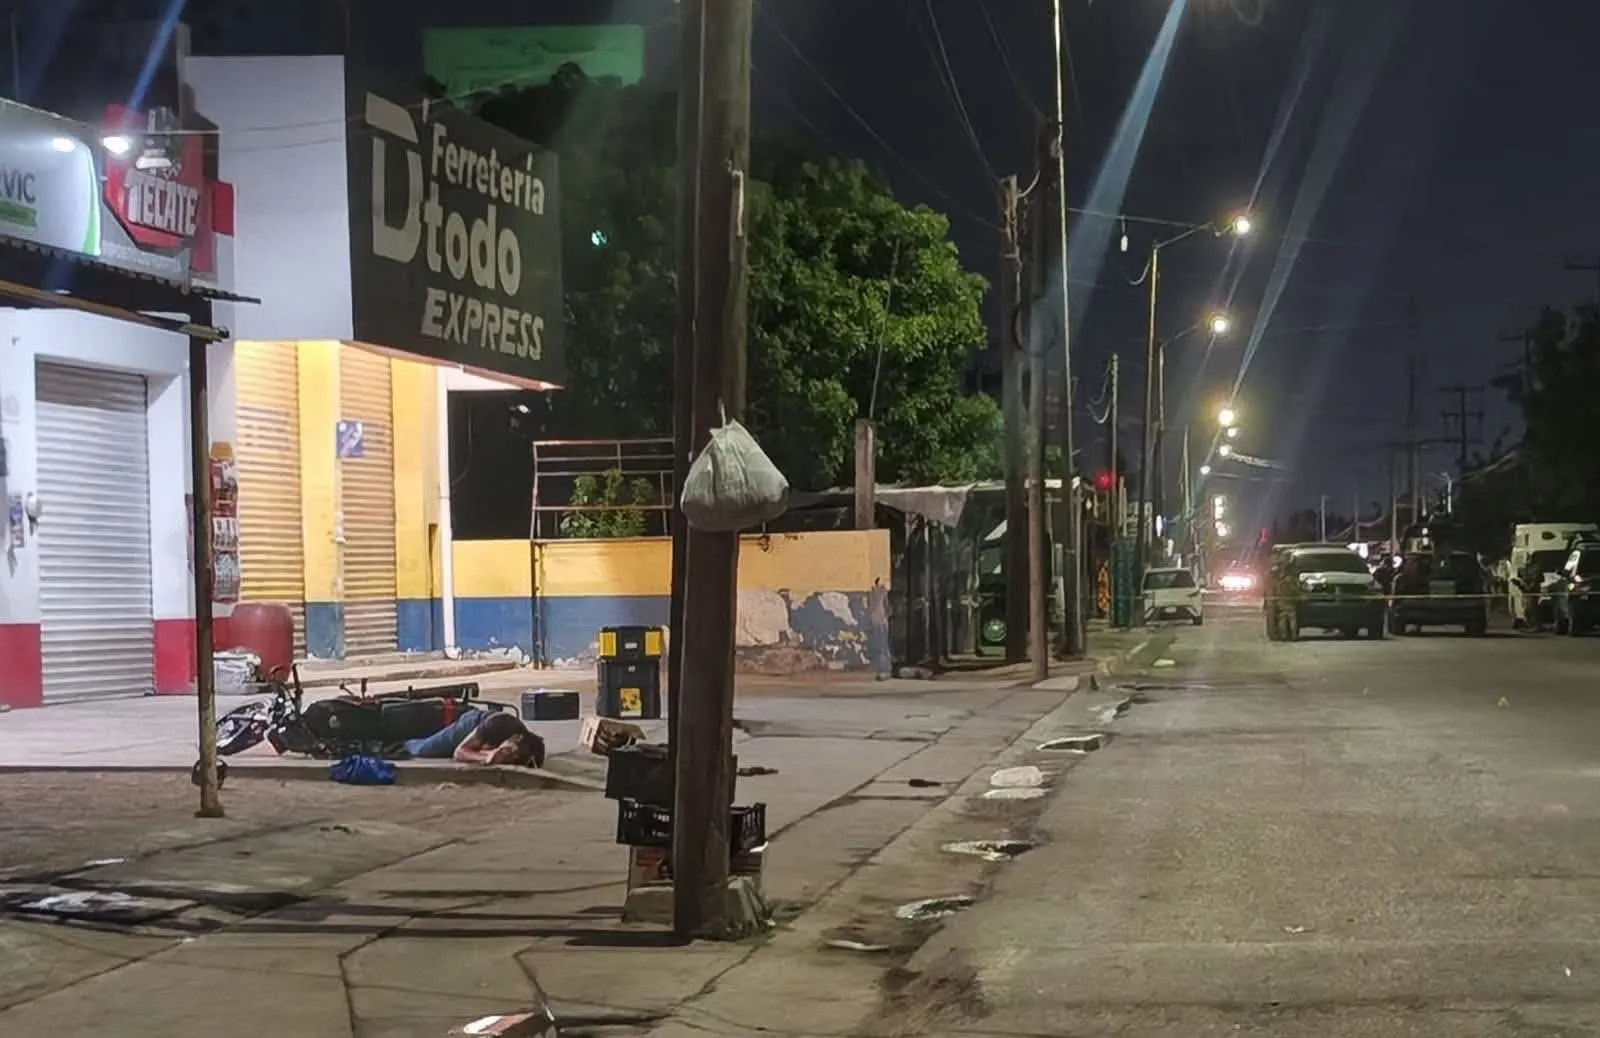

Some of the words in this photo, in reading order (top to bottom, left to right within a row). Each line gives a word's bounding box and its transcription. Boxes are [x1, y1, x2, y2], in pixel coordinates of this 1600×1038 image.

[0, 170, 37, 204] VIC
[126, 168, 199, 238] TECATE
[432, 123, 545, 215] Ferretería
[421, 287, 545, 361] EXPRESS
